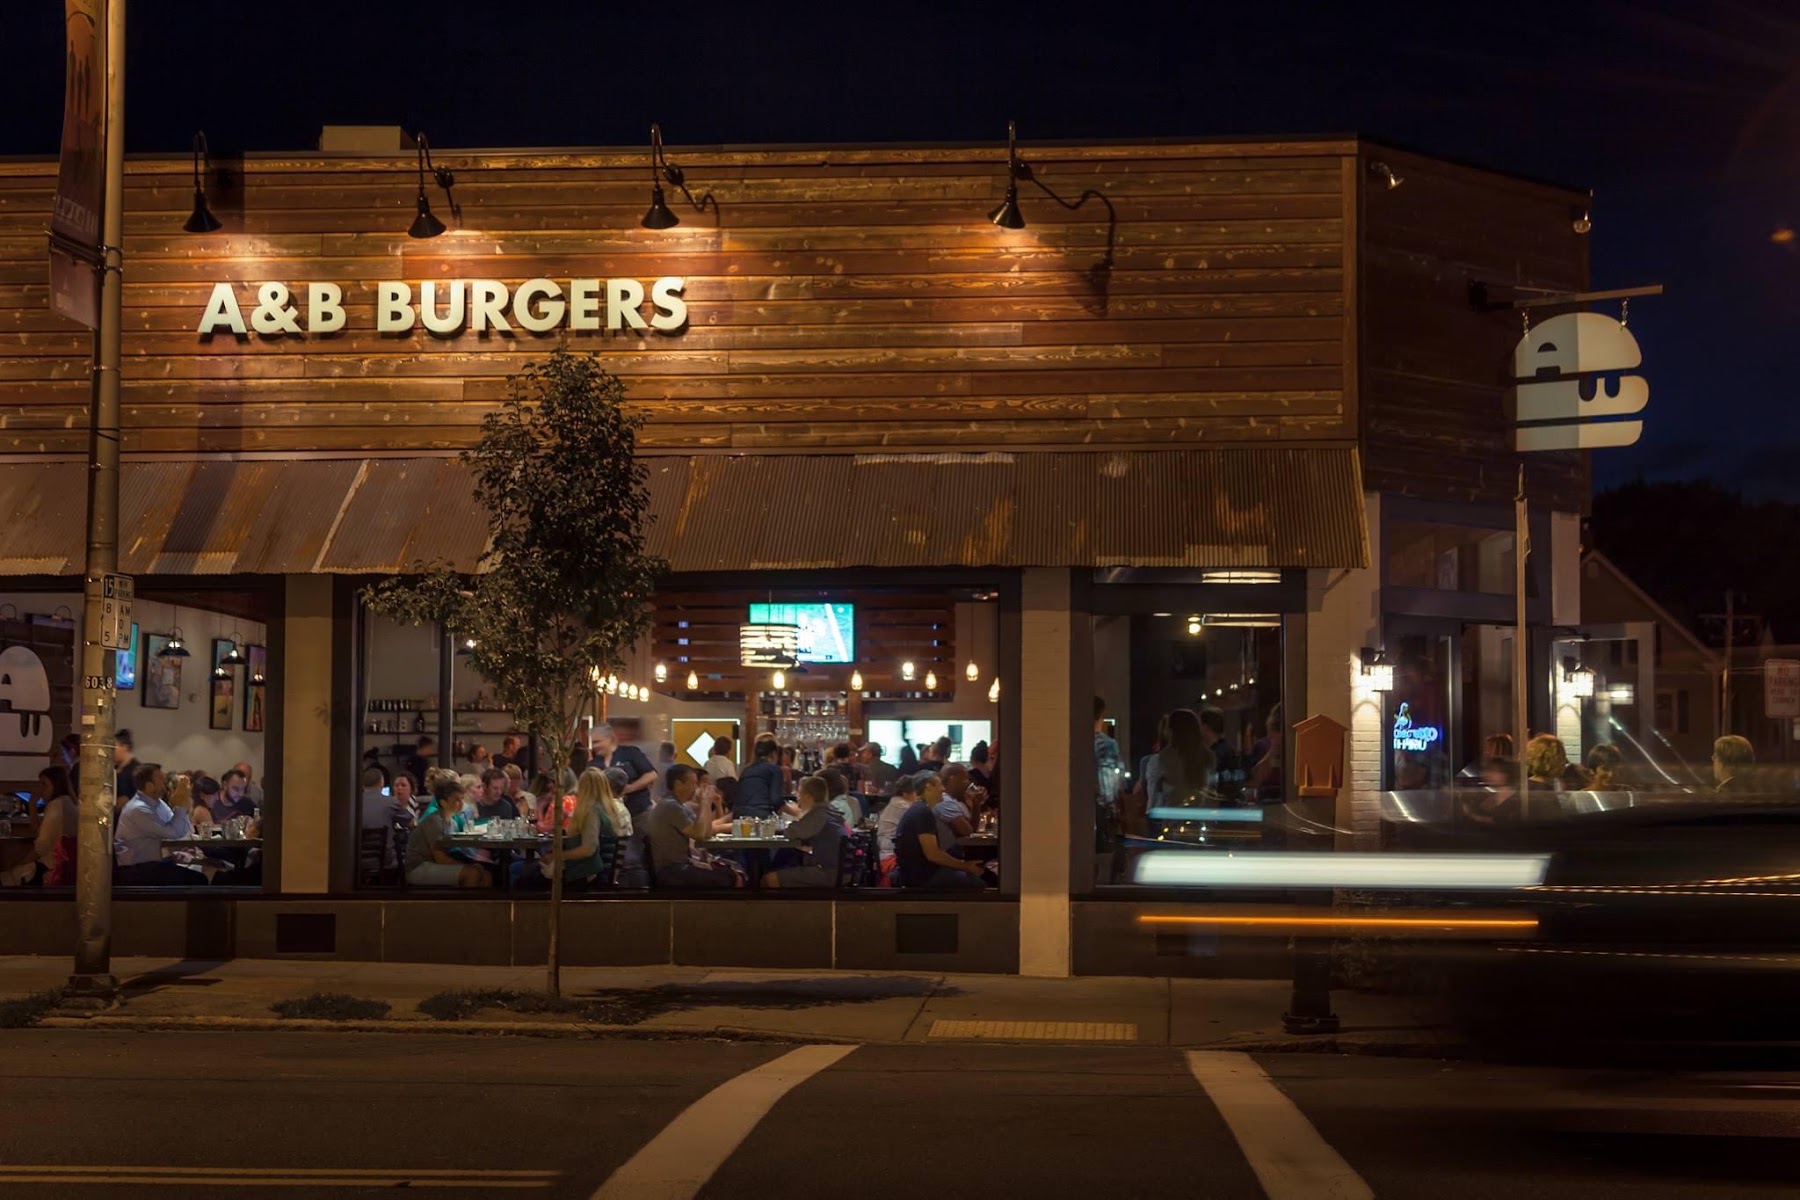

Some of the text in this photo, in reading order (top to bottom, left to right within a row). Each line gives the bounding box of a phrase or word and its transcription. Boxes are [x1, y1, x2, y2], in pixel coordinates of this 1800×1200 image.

[197, 276, 689, 334] A&B BURGERS
[105, 579, 113, 597] 15
[106, 602, 130, 615] 8 AM
[104, 631, 129, 643] 5 PM
